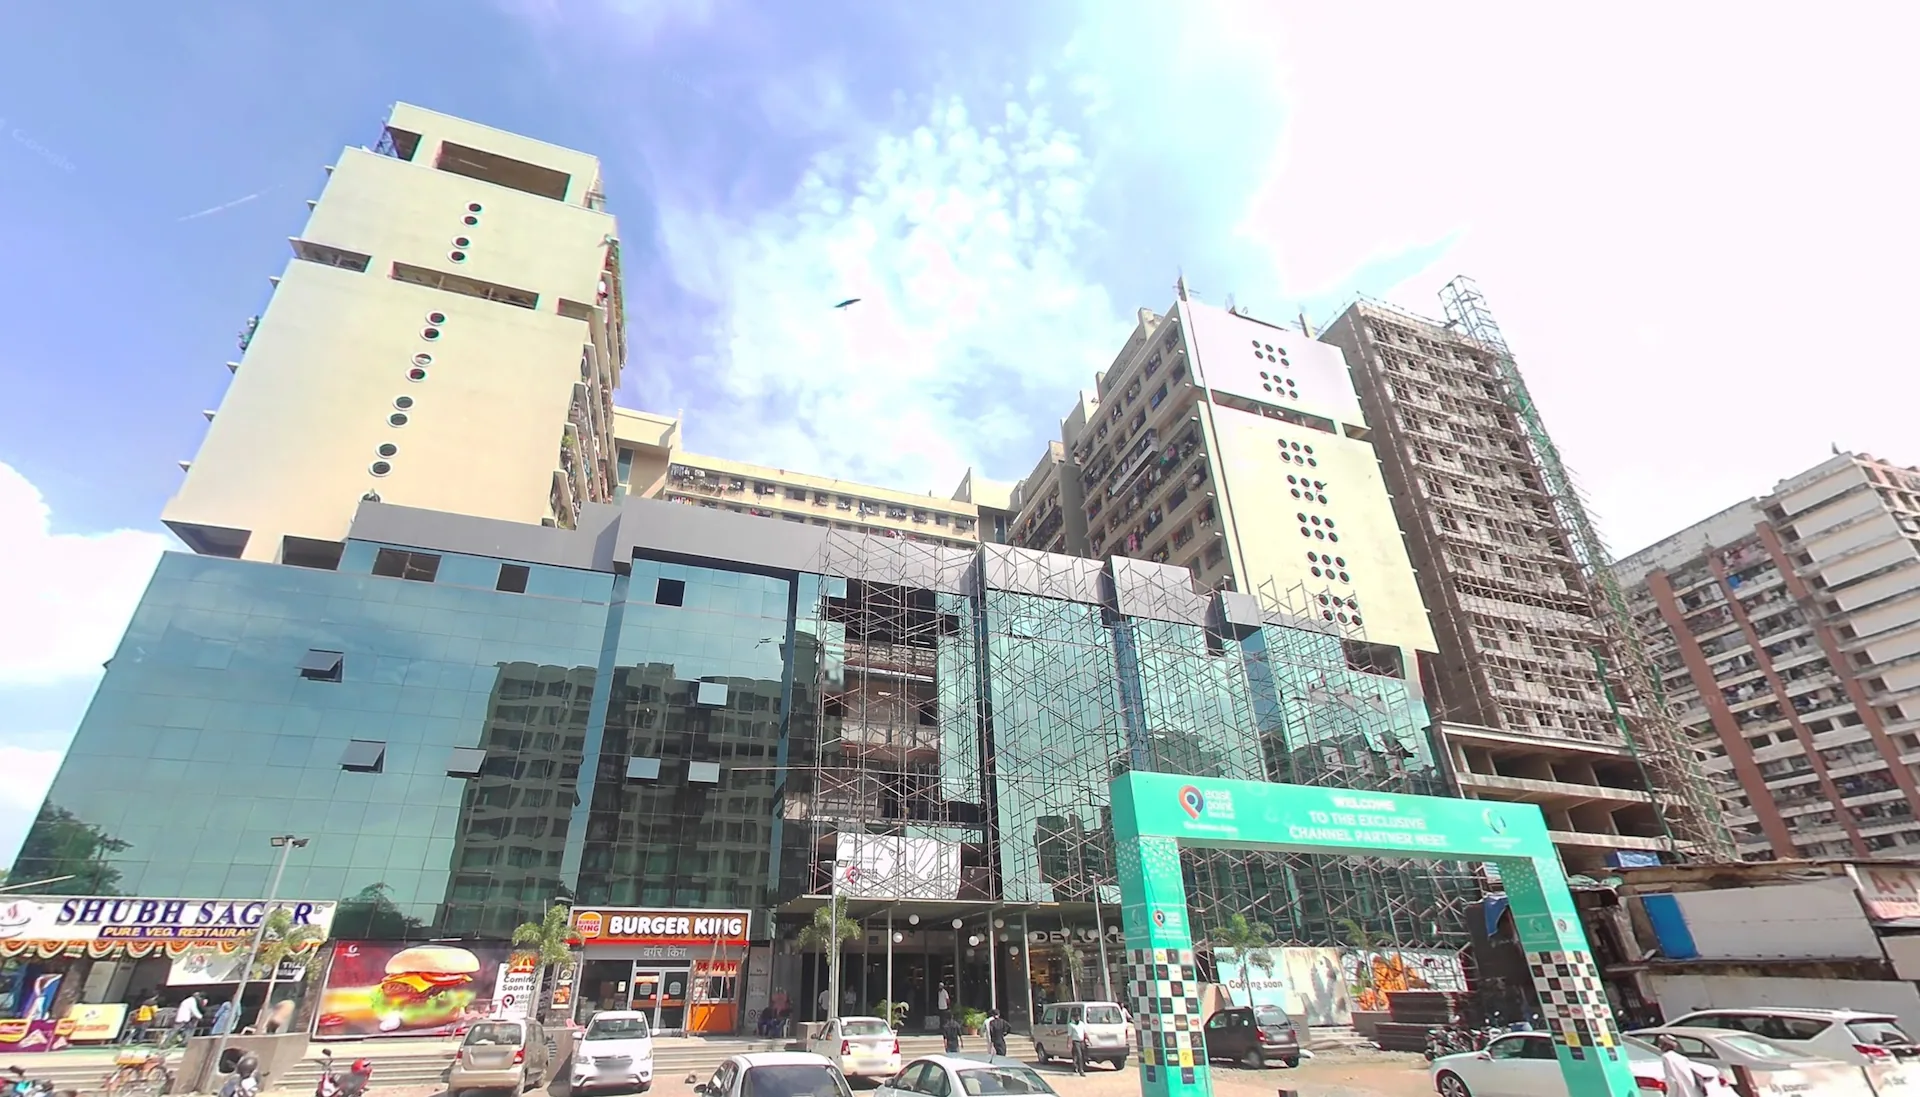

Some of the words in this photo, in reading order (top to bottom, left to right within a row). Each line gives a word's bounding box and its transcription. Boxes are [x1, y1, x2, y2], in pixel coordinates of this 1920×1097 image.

[1331, 797, 1396, 812] WELCOME
[1309, 811, 1329, 824] TO
[1331, 813, 1356, 826] THE
[1358, 814, 1427, 830] EXCLUSIVE
[1289, 825, 1353, 841] CHANNEL
[1355, 830, 1413, 845] PARTNER
[55, 899, 188, 925] SHUBH
[195, 899, 314, 925] SAGR
[103, 926, 142, 937] PURE
[177, 927, 258, 937] RESTAURA
[577, 924, 600, 932] KING
[609, 916, 690, 935] BURGER
[694, 918, 742, 935] KING
[503, 976, 536, 984] Coming
[1229, 980, 1262, 991] Cong
